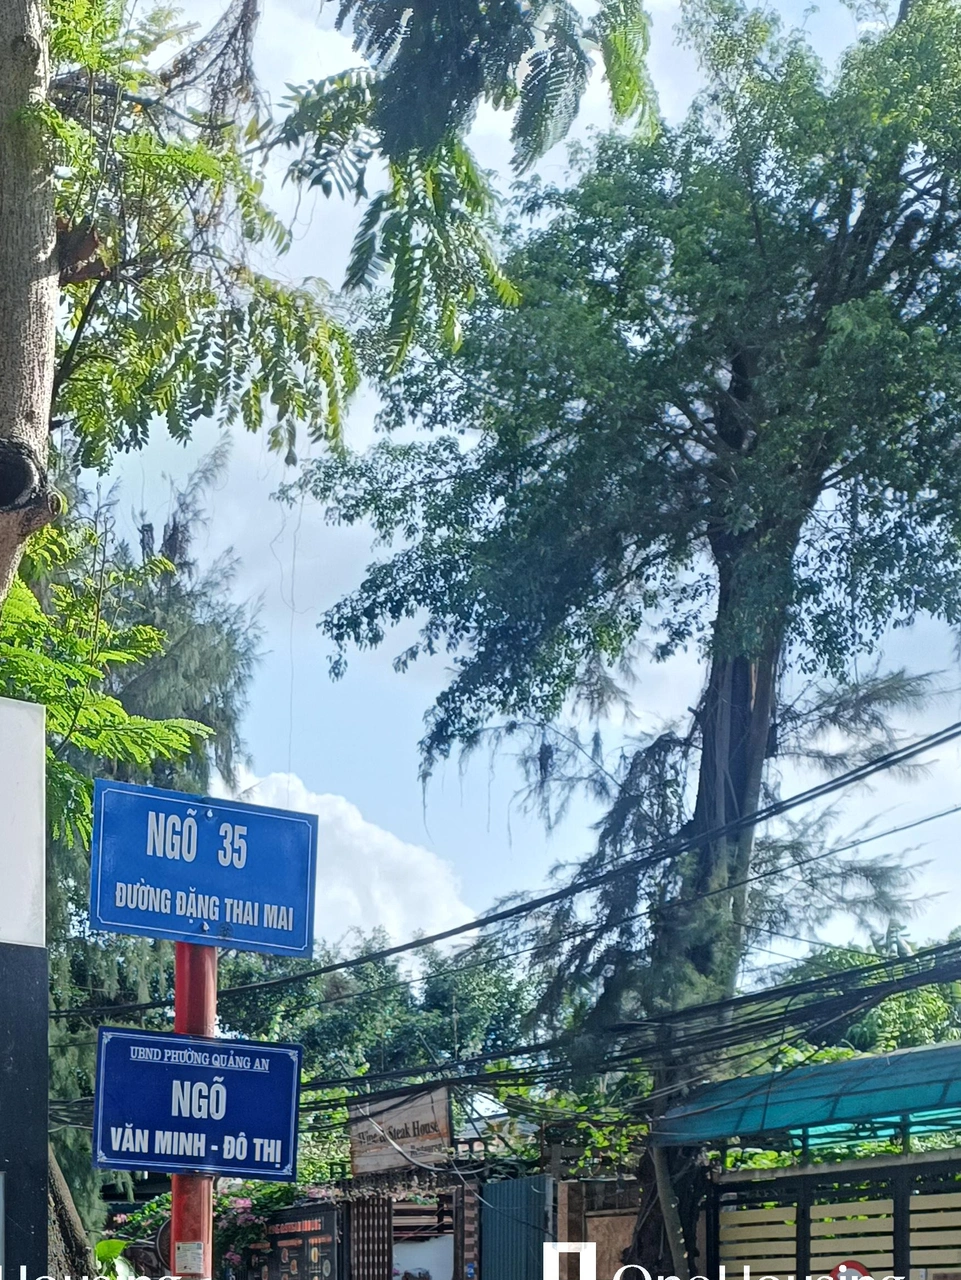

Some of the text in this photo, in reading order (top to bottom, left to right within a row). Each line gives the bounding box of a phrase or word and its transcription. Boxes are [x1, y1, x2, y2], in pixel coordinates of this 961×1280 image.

[146, 809, 248, 869] NGÕ 35
[115, 878, 294, 931] ĐƯỜNG ĐẶNG THAI MAI
[130, 1046, 270, 1071] UBND PHƯỜNG QUẢNG AN
[171, 1076, 227, 1120] NGÕ
[110, 1122, 149, 1153] VĂN
[154, 1130, 206, 1157] MINH
[223, 1132, 248, 1160] ĐÔ
[253, 1138, 282, 1168] THỊ
[387, 1122, 411, 1141] Steak
[412, 1120, 440, 1138] House
